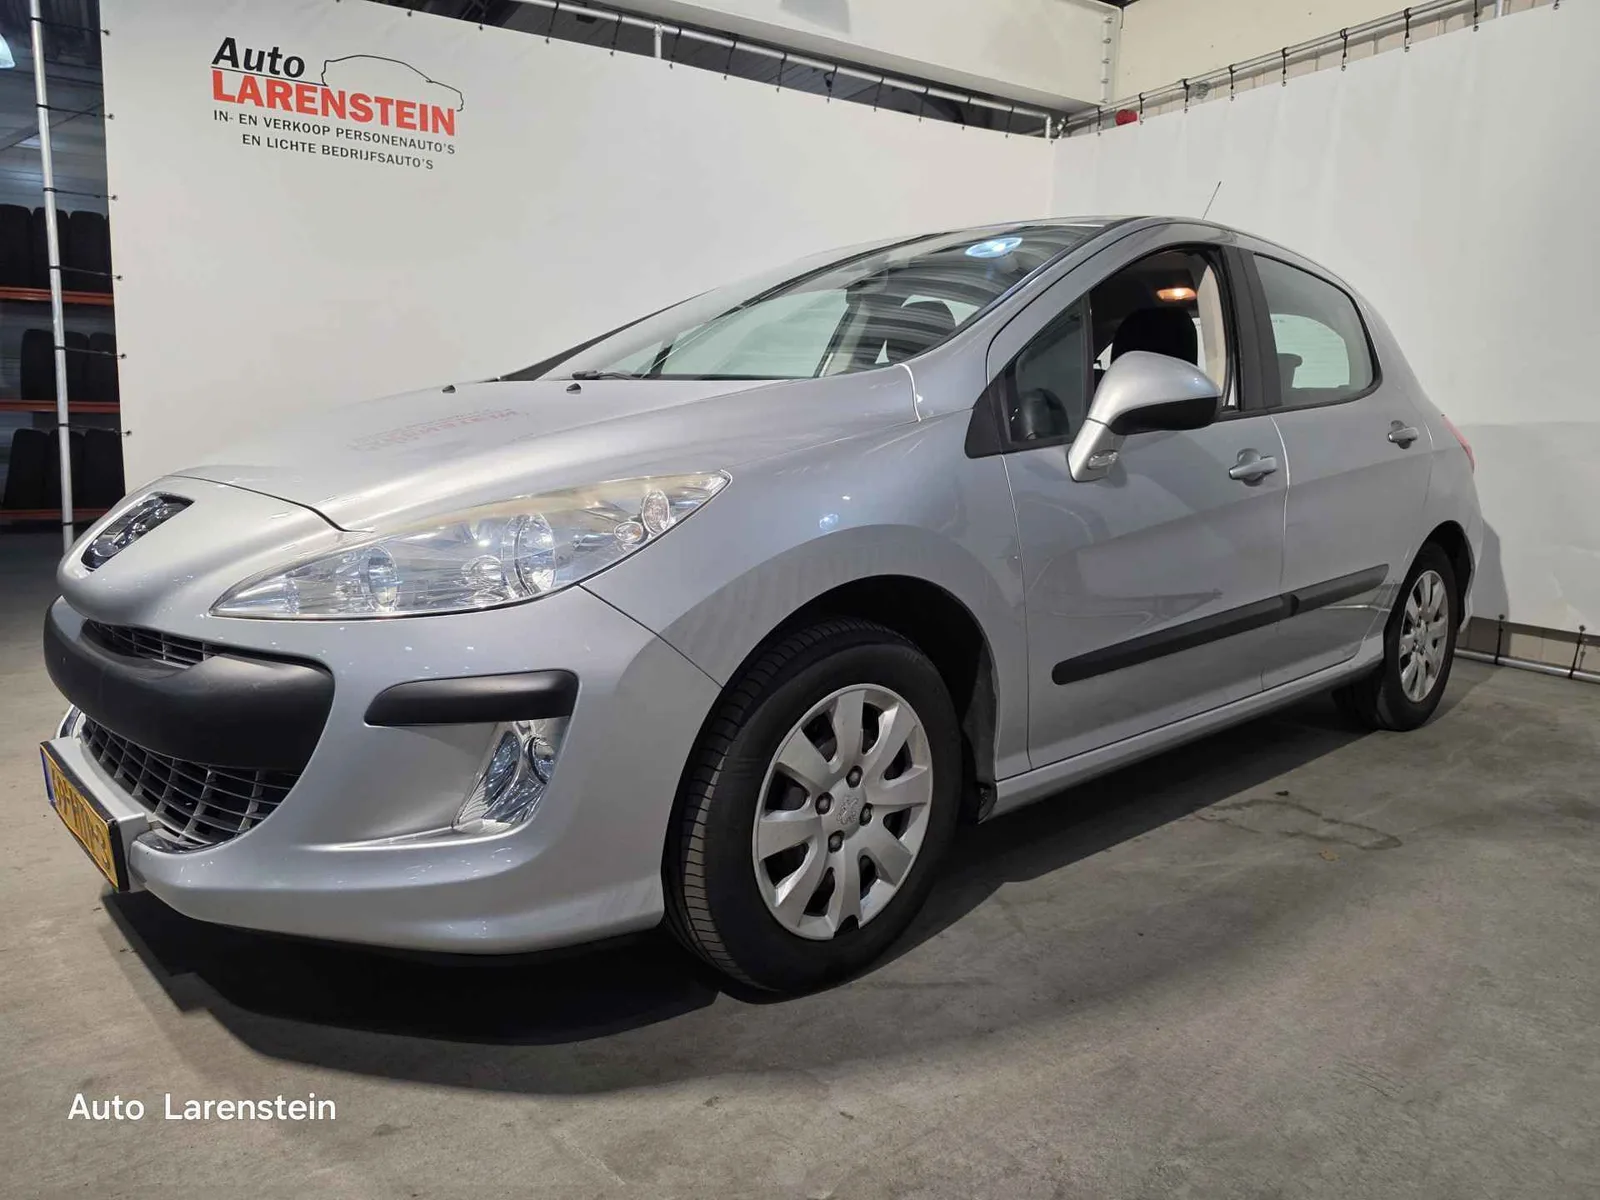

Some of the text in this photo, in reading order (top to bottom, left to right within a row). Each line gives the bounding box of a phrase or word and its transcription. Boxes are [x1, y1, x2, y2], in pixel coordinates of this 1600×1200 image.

[211, 36, 306, 79] Auto
[211, 69, 456, 136] LARENSTEIN
[213, 109, 456, 155] IN- EN VERKOOP PERSONENAUTO'S
[242, 133, 434, 170] EN LICHTE BEDRIJFSAUTO'S
